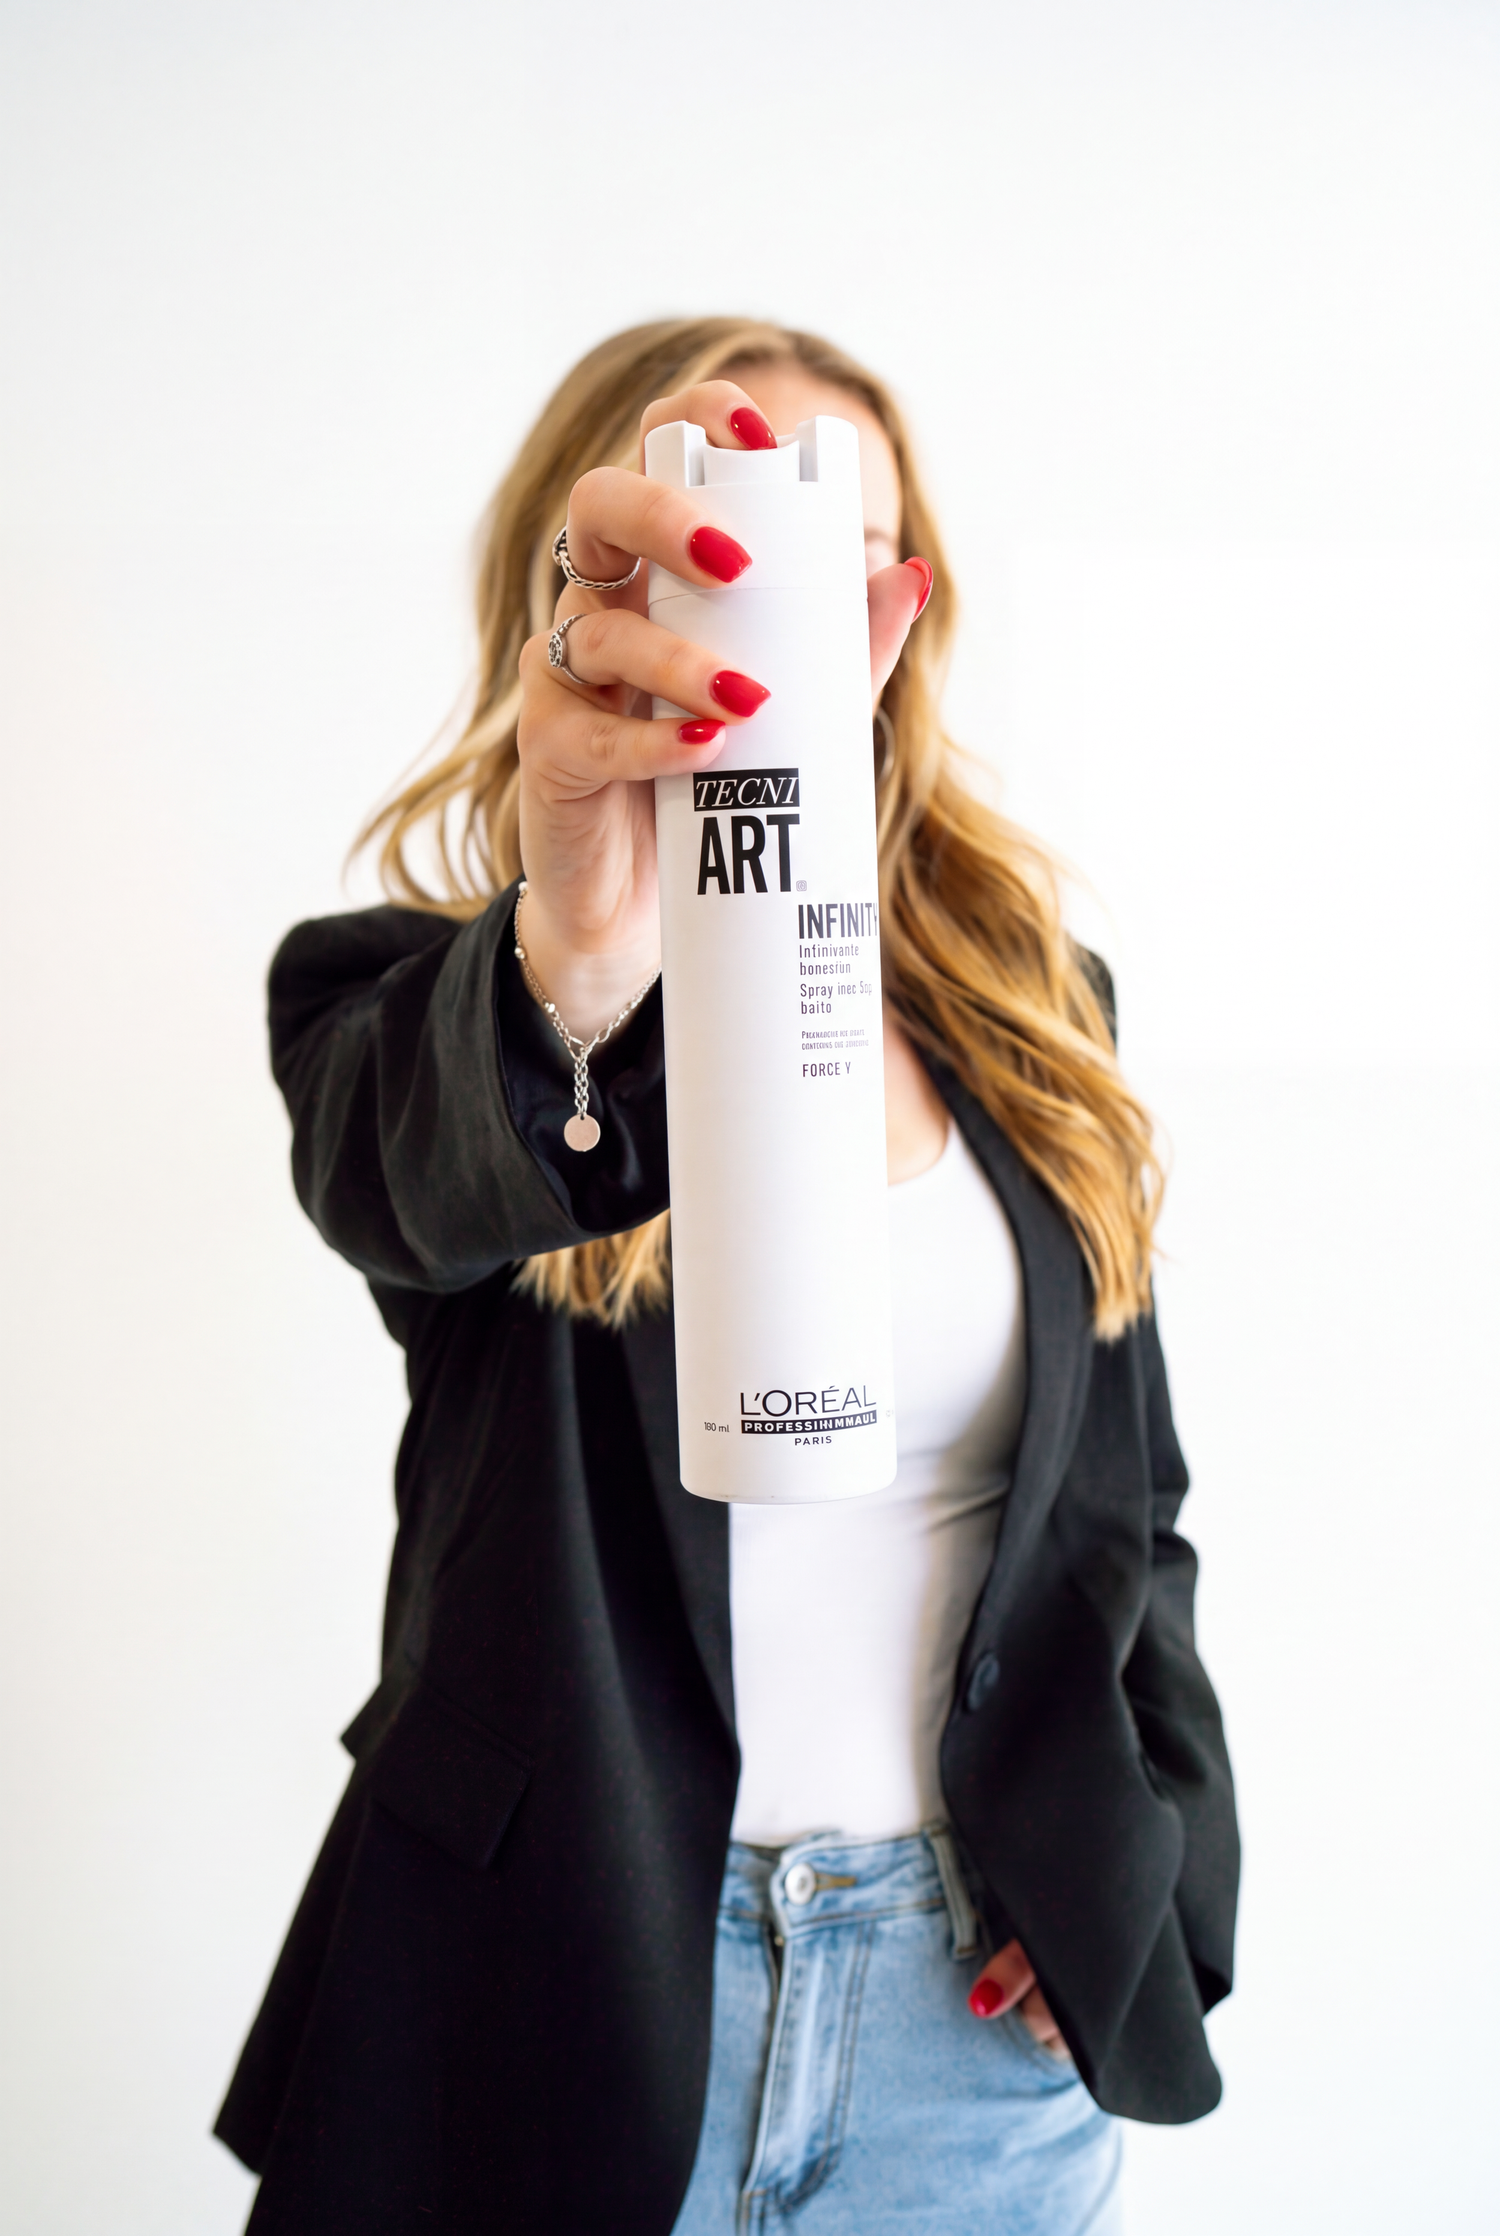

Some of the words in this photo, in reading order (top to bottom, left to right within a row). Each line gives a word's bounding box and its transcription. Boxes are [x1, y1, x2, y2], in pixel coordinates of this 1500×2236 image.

[696, 776, 799, 808] TECNI
[697, 814, 800, 895] ART
[800, 983, 833, 1000] Spray
[801, 1000, 832, 1015] baito
[802, 1062, 841, 1077] FORCE
[740, 1385, 877, 1417] L'ORÉAL
[794, 1435, 832, 1446] PARIS
